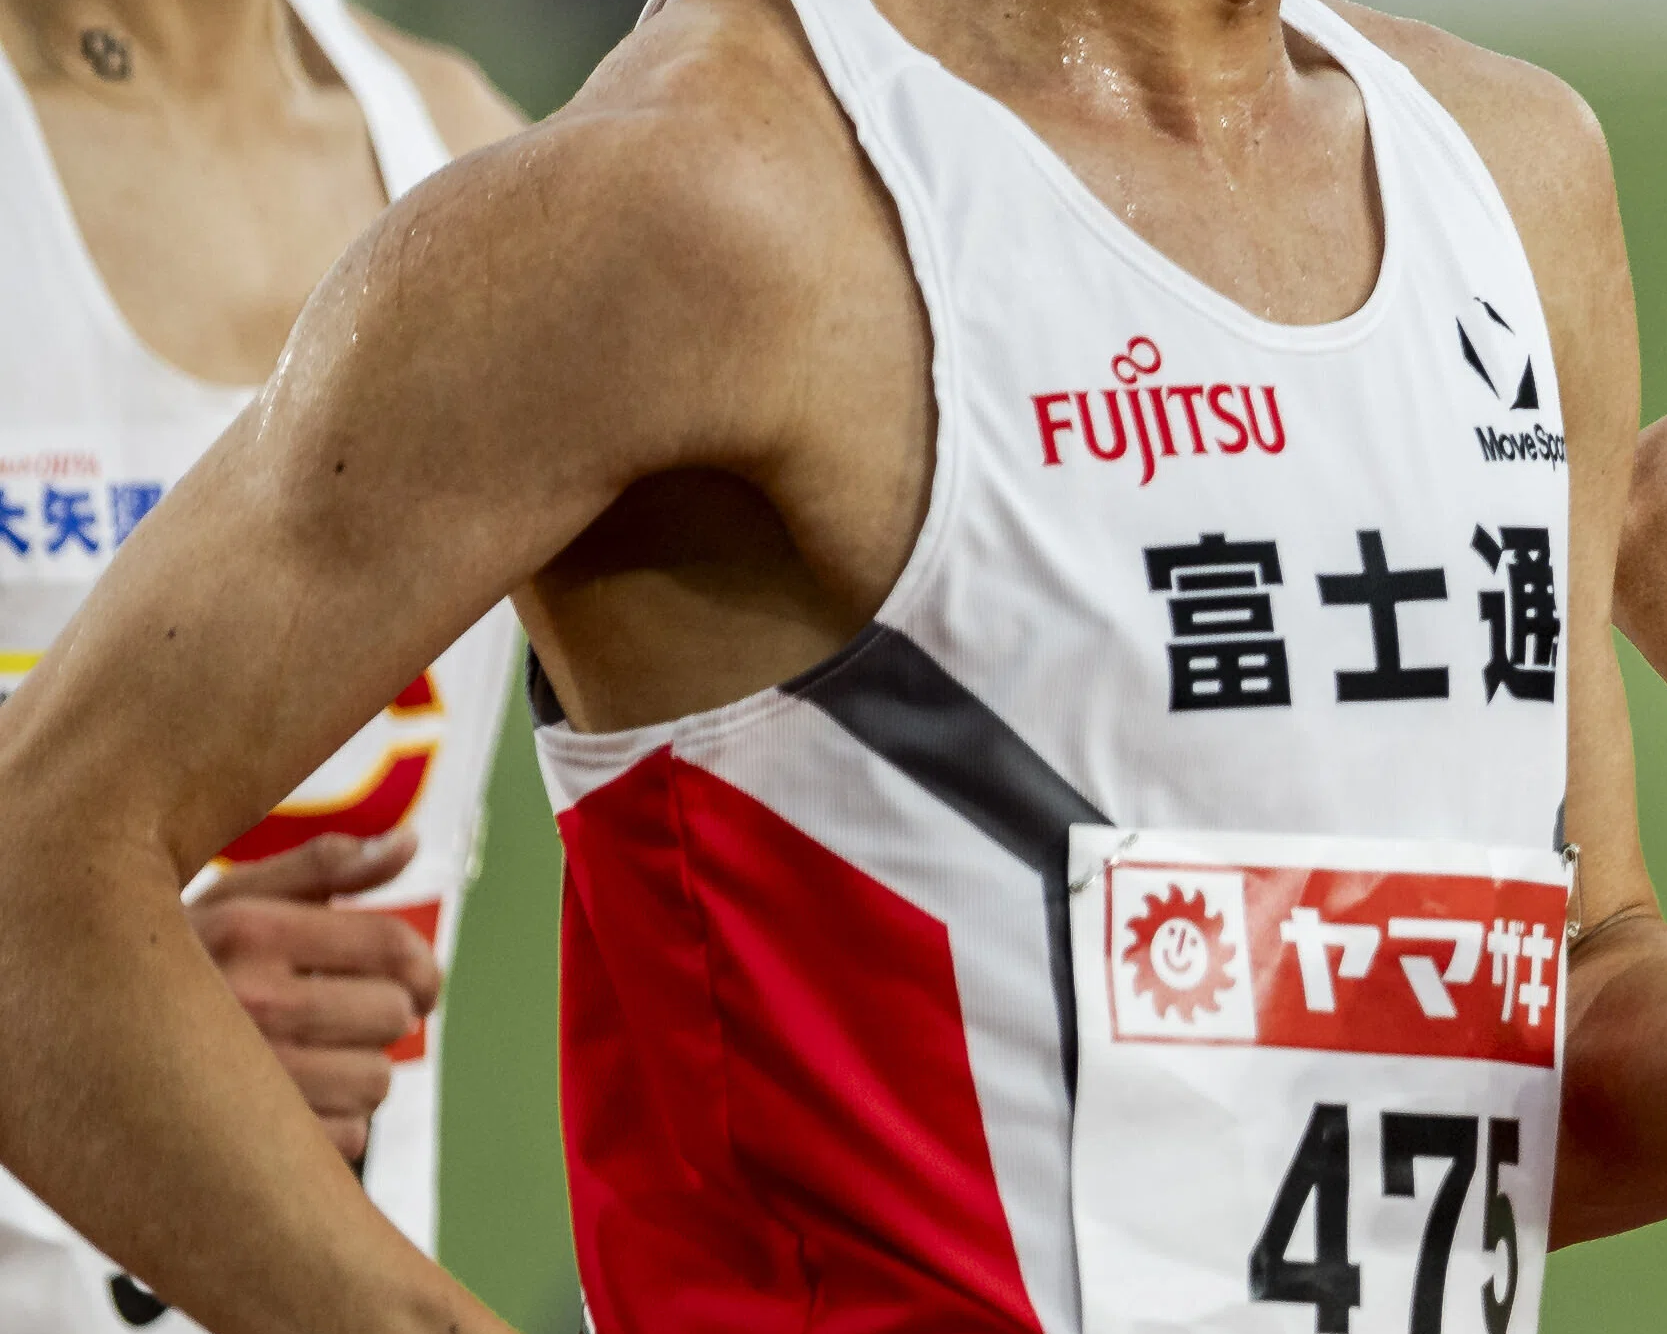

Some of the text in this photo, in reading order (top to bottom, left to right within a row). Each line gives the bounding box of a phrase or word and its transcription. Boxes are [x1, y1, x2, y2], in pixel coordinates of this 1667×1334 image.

[1030, 336, 1287, 487] FUJITSU
[1143, 523, 1561, 713] 富士通
[1279, 905, 1556, 1028] ヤマザキ
